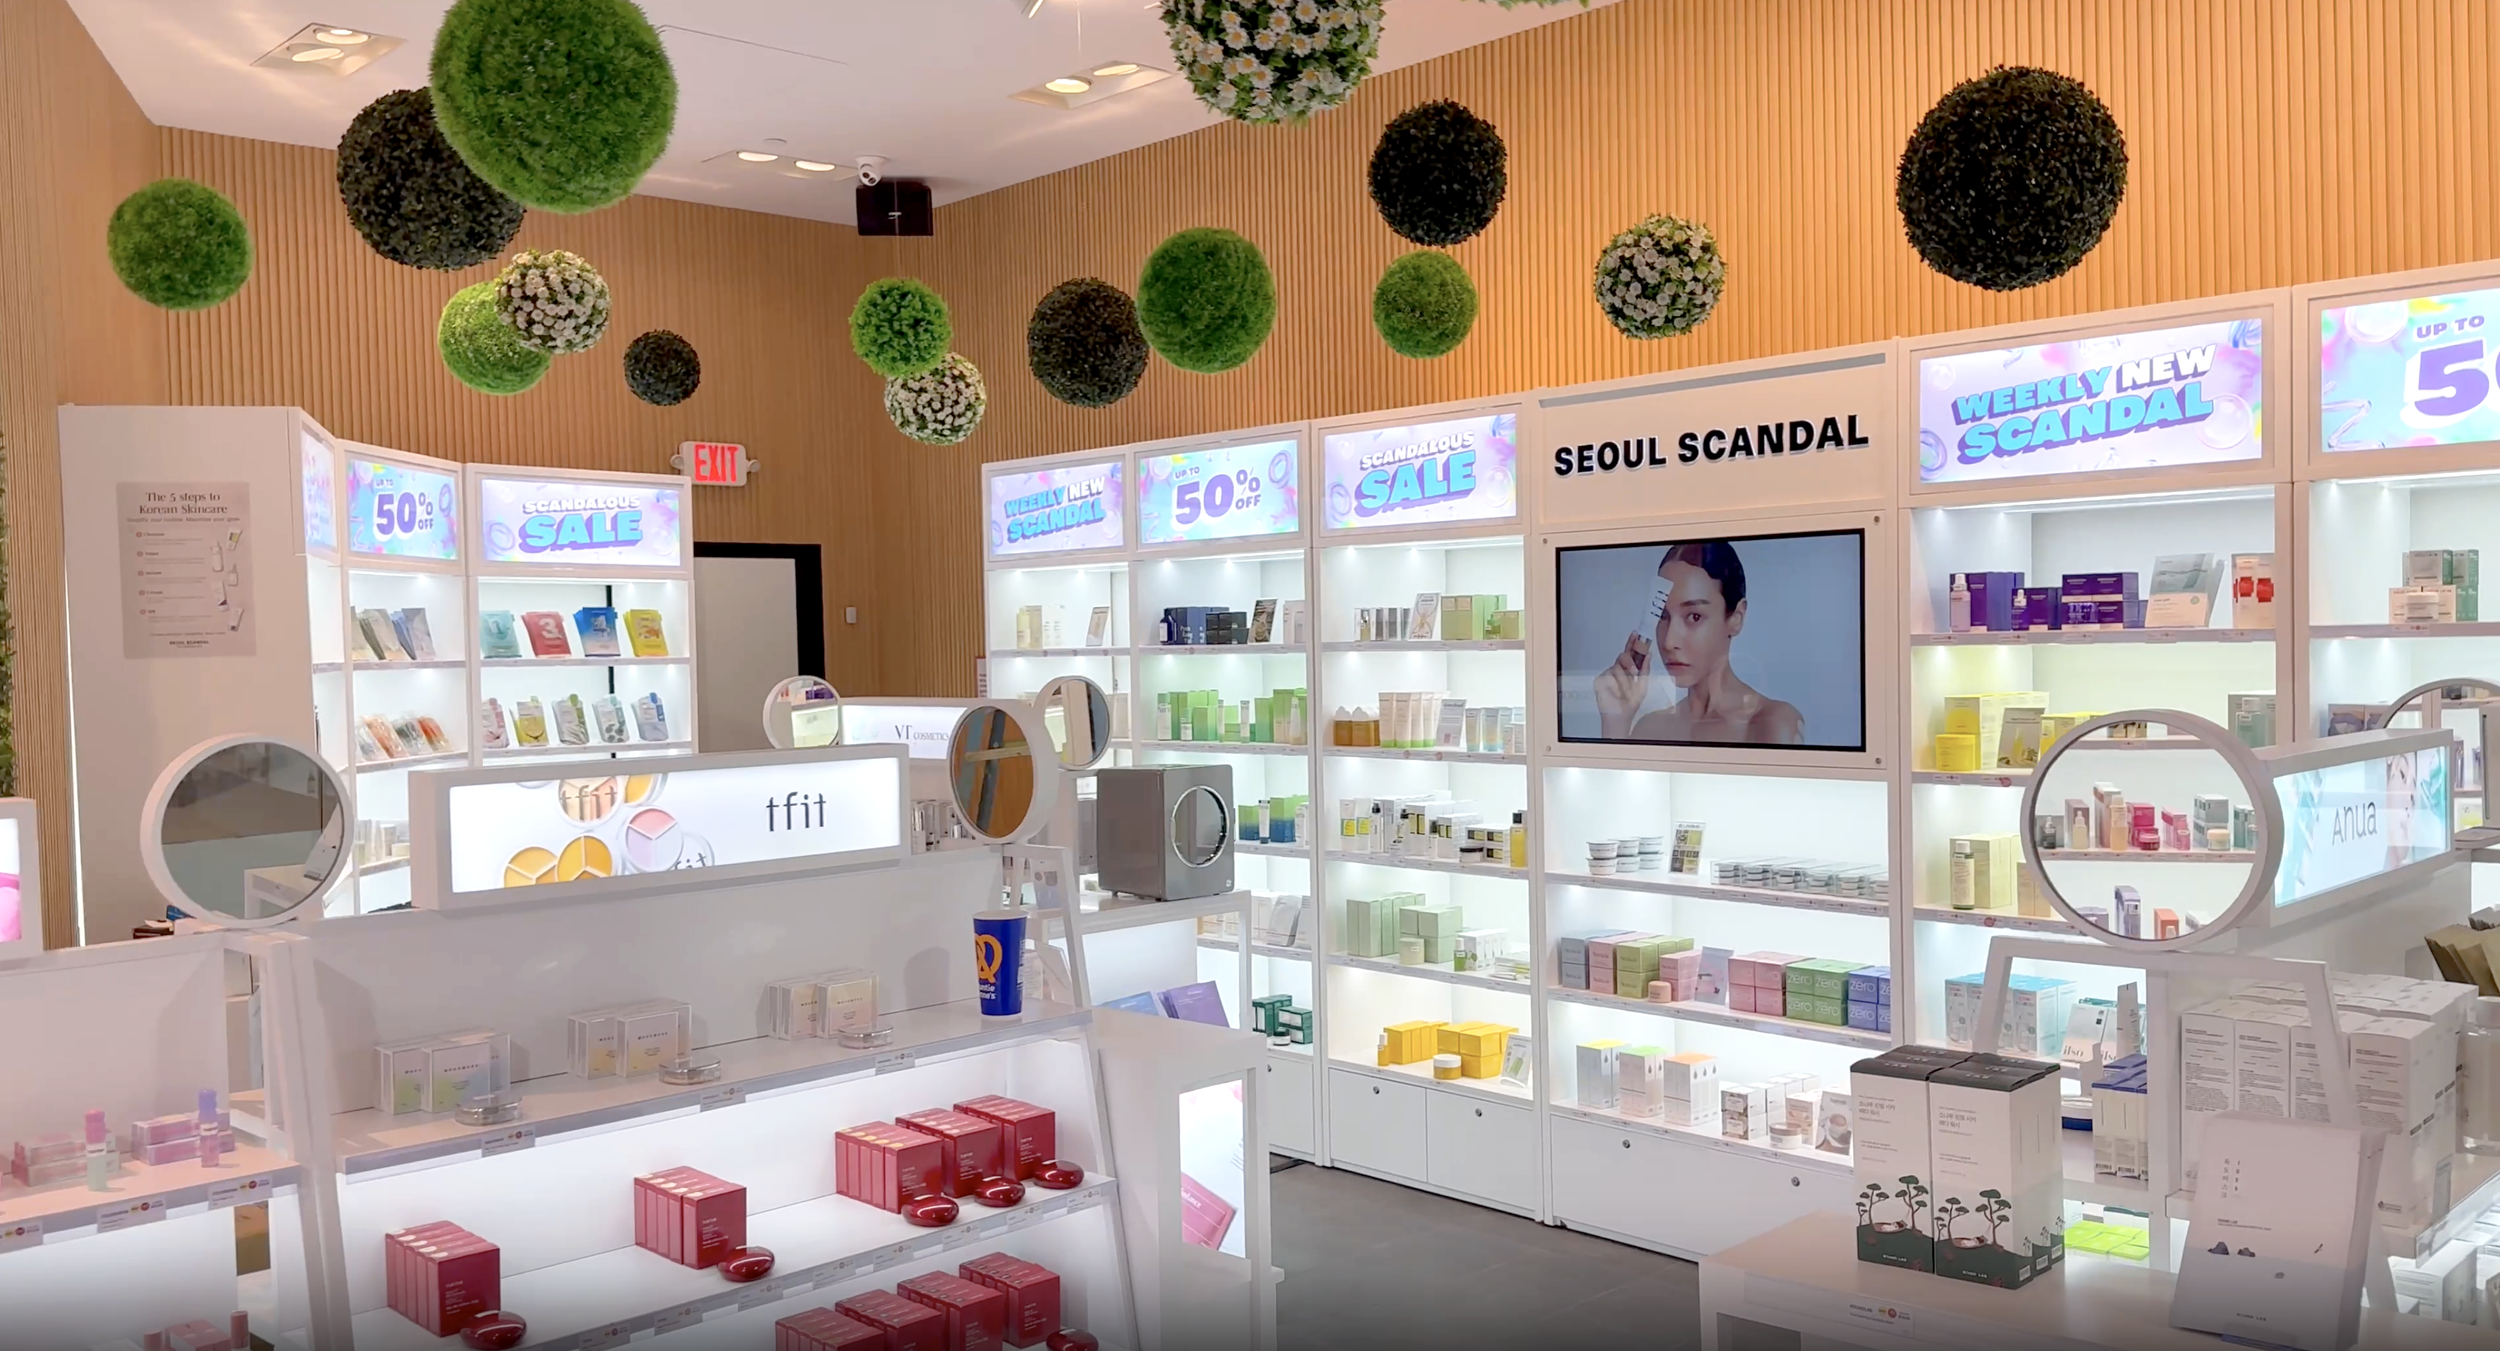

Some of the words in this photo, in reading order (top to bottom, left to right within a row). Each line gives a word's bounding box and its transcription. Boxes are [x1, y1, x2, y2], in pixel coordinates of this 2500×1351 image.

[2416, 322, 2448, 339] UP
[2454, 315, 2485, 331] TO
[1951, 366, 2112, 425] WEEKLY
[2116, 344, 2217, 393] NEW
[2413, 339, 2500, 416] 5
[1957, 381, 2214, 465] SCANDAL
[1360, 430, 1475, 471] SCANDALOUS
[1554, 436, 1667, 477] SEOUL
[1677, 414, 1870, 463] SCANDAL
[694, 444, 739, 483] EXIT
[1174, 469, 1188, 480] UP
[1188, 466, 1200, 476] TO
[375, 479, 384, 487] UP
[386, 479, 394, 488] TO
[1356, 450, 1476, 515] SALE
[139, 505, 178, 514] Korean
[181, 504, 228, 514] Skincare
[145, 492, 166, 502] The
[170, 493, 176, 502] 5
[179, 493, 206, 503] steps
[209, 493, 221, 501] to
[523, 495, 641, 514] SCANDALOUS
[1004, 486, 1065, 518] WEEKLY
[1067, 476, 1106, 503] NEW
[1235, 494, 1262, 510] OFF
[418, 518, 434, 531] OFF
[520, 510, 643, 552] SALE
[1007, 498, 1106, 543] SCANDAL
[894, 724, 913, 740] VT
[765, 791, 827, 832] tfit
[2331, 801, 2378, 847] Anua
[1815, 976, 1841, 990] zero
[1850, 980, 1876, 993] zero
[1815, 1004, 1840, 1018] zero
[1850, 1007, 1876, 1021] zero
